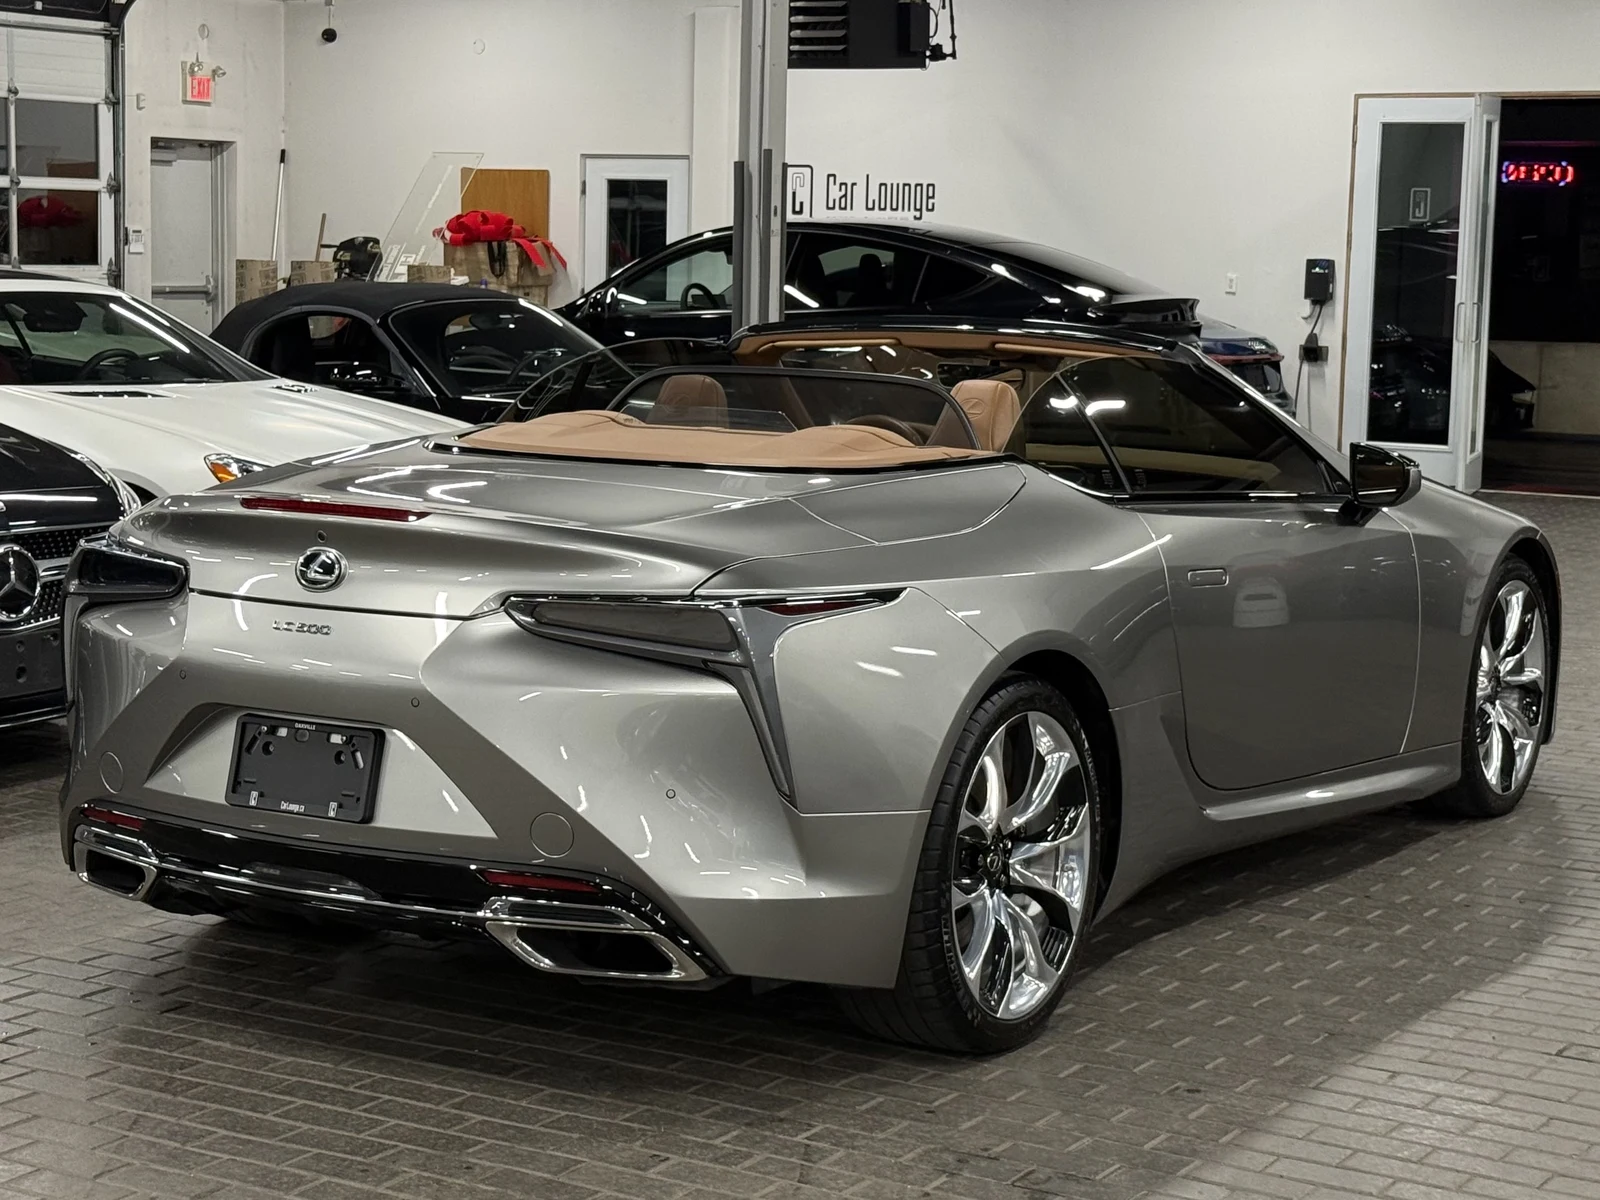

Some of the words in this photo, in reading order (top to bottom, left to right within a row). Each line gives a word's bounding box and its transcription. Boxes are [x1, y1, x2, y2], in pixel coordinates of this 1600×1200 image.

[191, 77, 211, 99] EXIT
[826, 173, 857, 211] Car
[865, 173, 935, 220] Lounge
